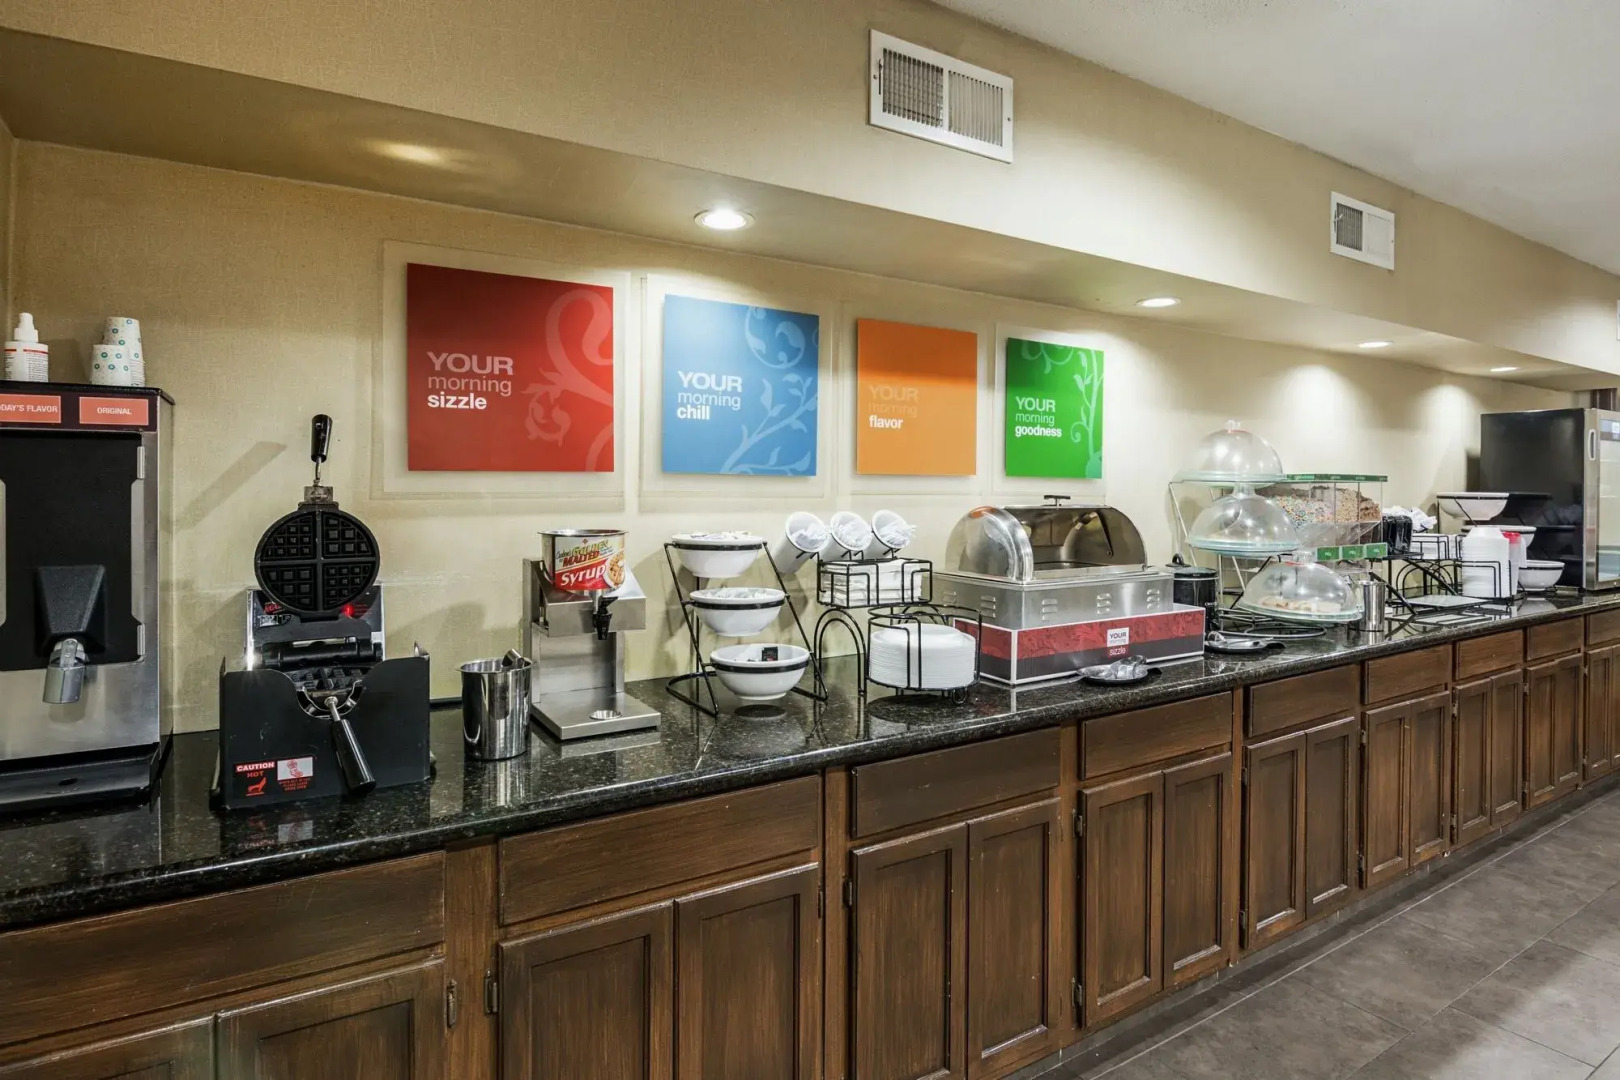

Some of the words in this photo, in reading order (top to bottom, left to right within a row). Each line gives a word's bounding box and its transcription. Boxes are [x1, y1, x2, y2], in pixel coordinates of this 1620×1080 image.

[427, 351, 514, 376] YOUR
[428, 375, 512, 397] morning
[677, 370, 743, 393] YOUR
[427, 391, 487, 410] sizzle
[677, 392, 741, 411] morning
[869, 385, 919, 403] YOUR
[0, 404, 25, 412] DAY'S
[26, 405, 58, 413] FLAVOR
[96, 407, 132, 415] ORIGINAL
[1015, 396, 1056, 412] YOUR
[676, 404, 711, 421] chill
[1015, 412, 1055, 427] morning
[869, 414, 904, 429] flavor
[1015, 424, 1063, 438] goodness
[560, 564, 607, 587] Syrup
[236, 761, 276, 772] CAUTION
[246, 770, 265, 778] HOT
